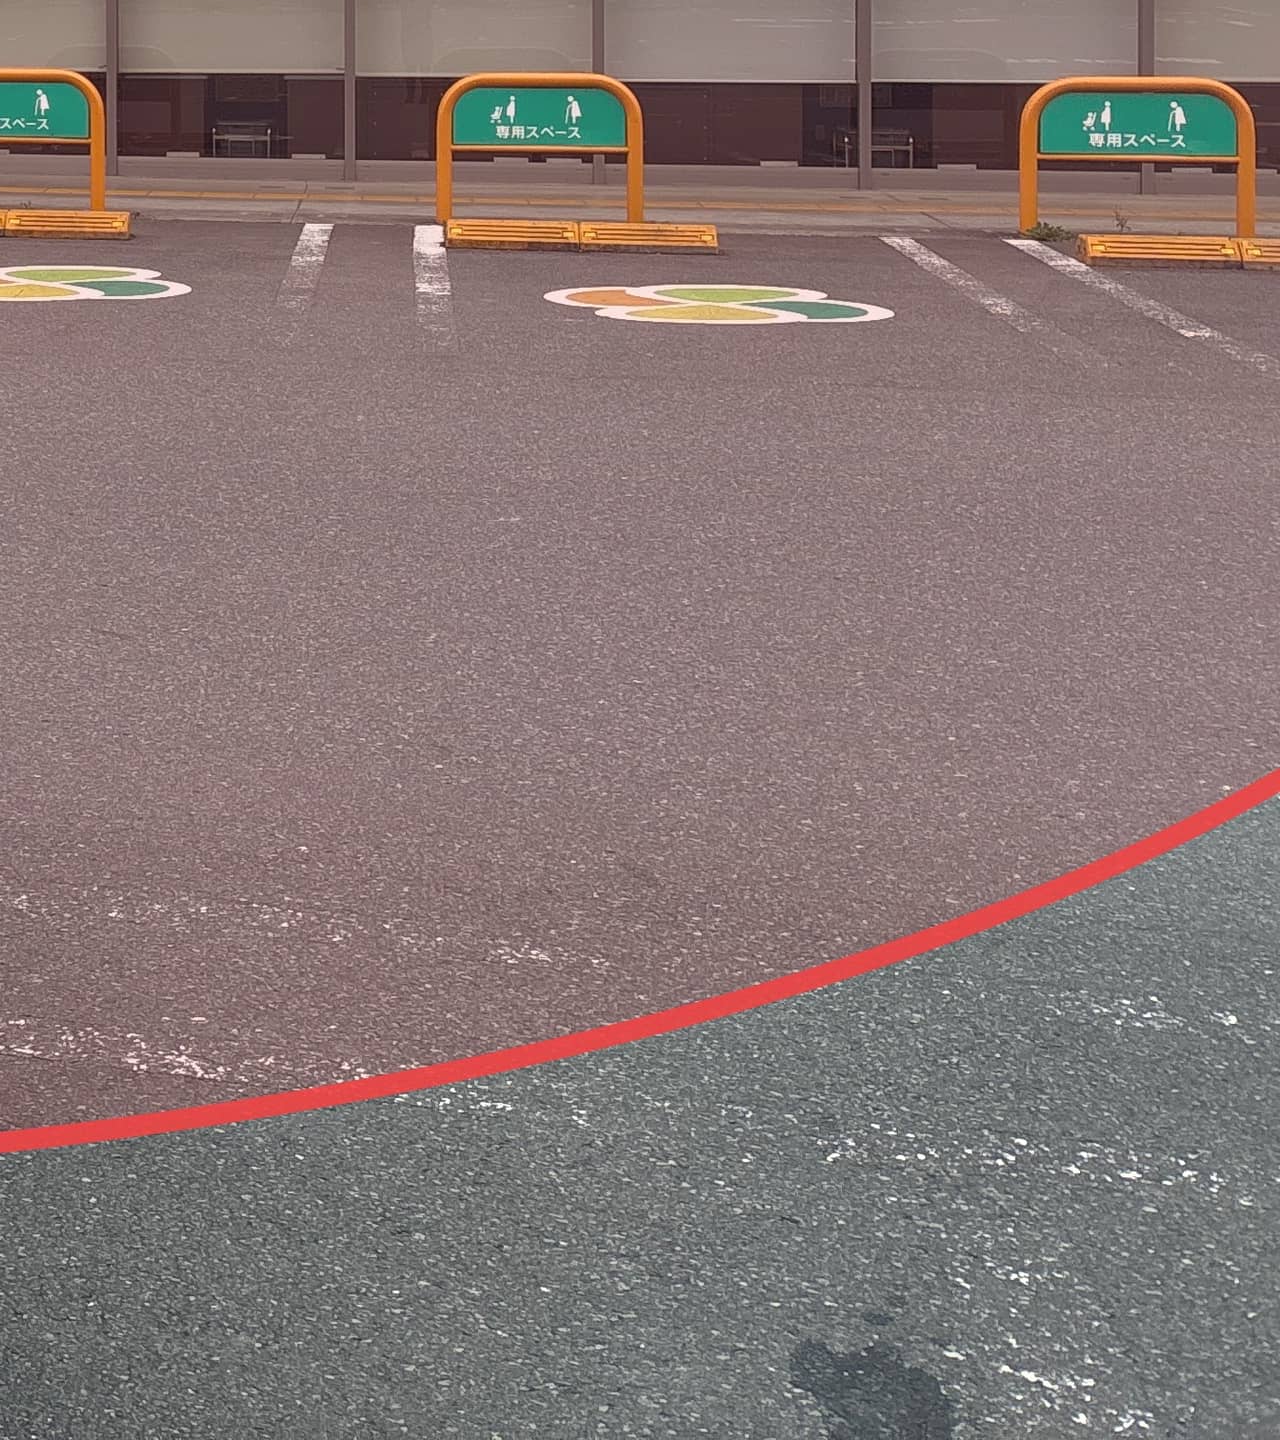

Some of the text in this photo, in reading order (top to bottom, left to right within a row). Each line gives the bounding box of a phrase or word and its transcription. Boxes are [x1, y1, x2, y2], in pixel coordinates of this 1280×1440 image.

[495, 125, 581, 139] 専用スペース
[1088, 133, 1186, 148] 専用スペース
